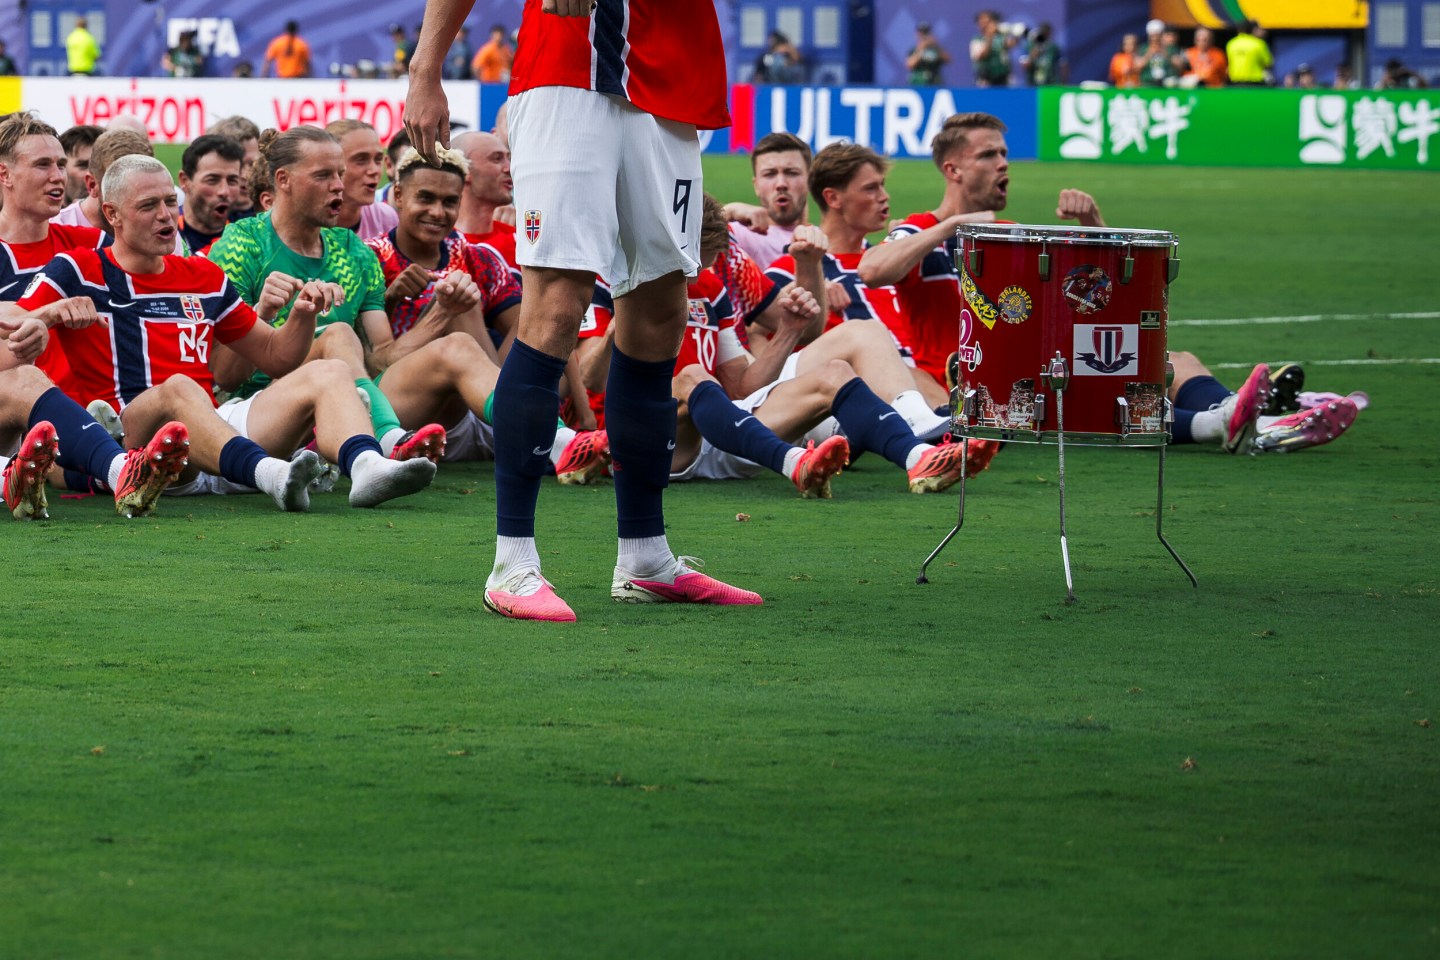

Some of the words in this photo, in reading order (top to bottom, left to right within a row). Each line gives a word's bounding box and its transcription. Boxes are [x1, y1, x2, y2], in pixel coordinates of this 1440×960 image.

[70, 78, 206, 141] verizon
[273, 79, 405, 146] verizo
[771, 87, 959, 156] ULTRA
[1107, 93, 1192, 159] 蒙牛
[1352, 96, 1440, 165] 蒙牛
[673, 178, 693, 234] 9
[176, 322, 211, 364] 26
[691, 327, 716, 371] 10
